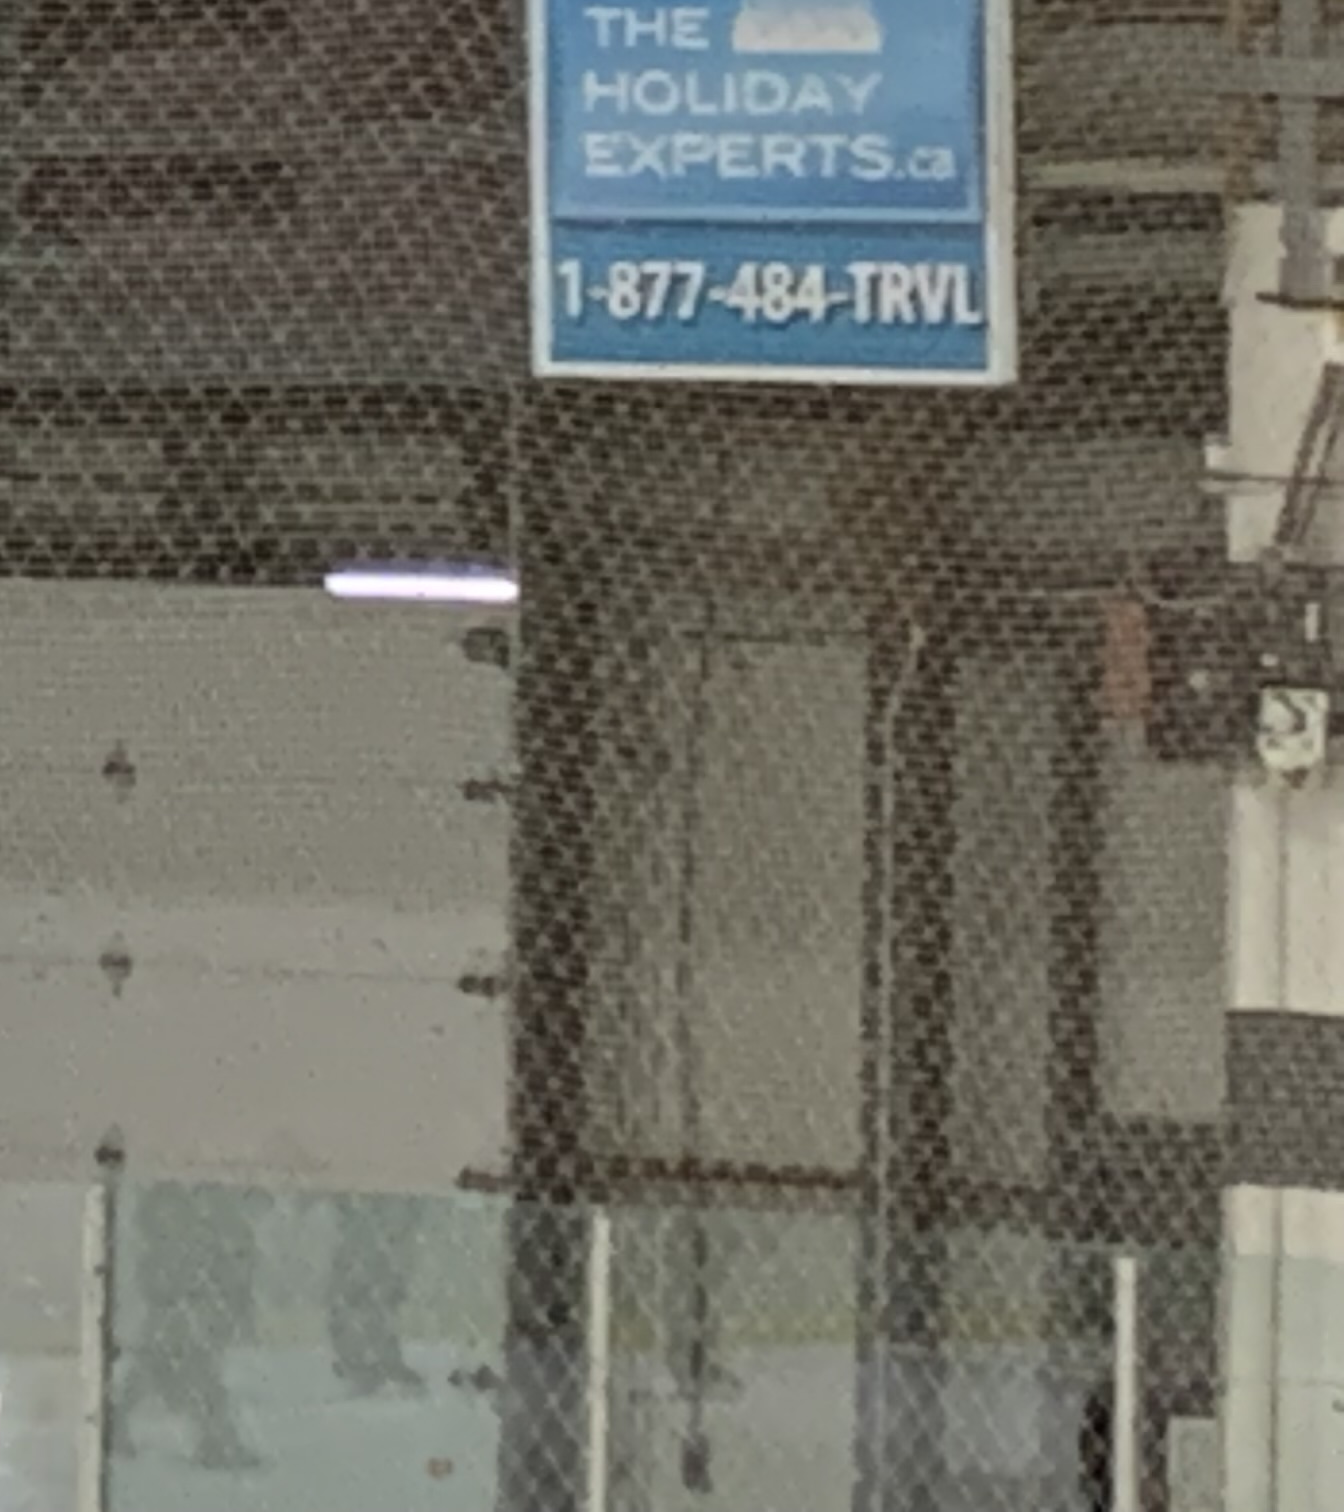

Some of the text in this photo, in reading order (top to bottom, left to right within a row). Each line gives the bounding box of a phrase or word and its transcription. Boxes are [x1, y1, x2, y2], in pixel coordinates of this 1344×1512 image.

[582, 6, 709, 51] THE
[582, 69, 882, 115] HOLIDAY
[583, 132, 955, 181] EXPERTS.ca
[557, 259, 984, 324] 1-877-484-TRVL
